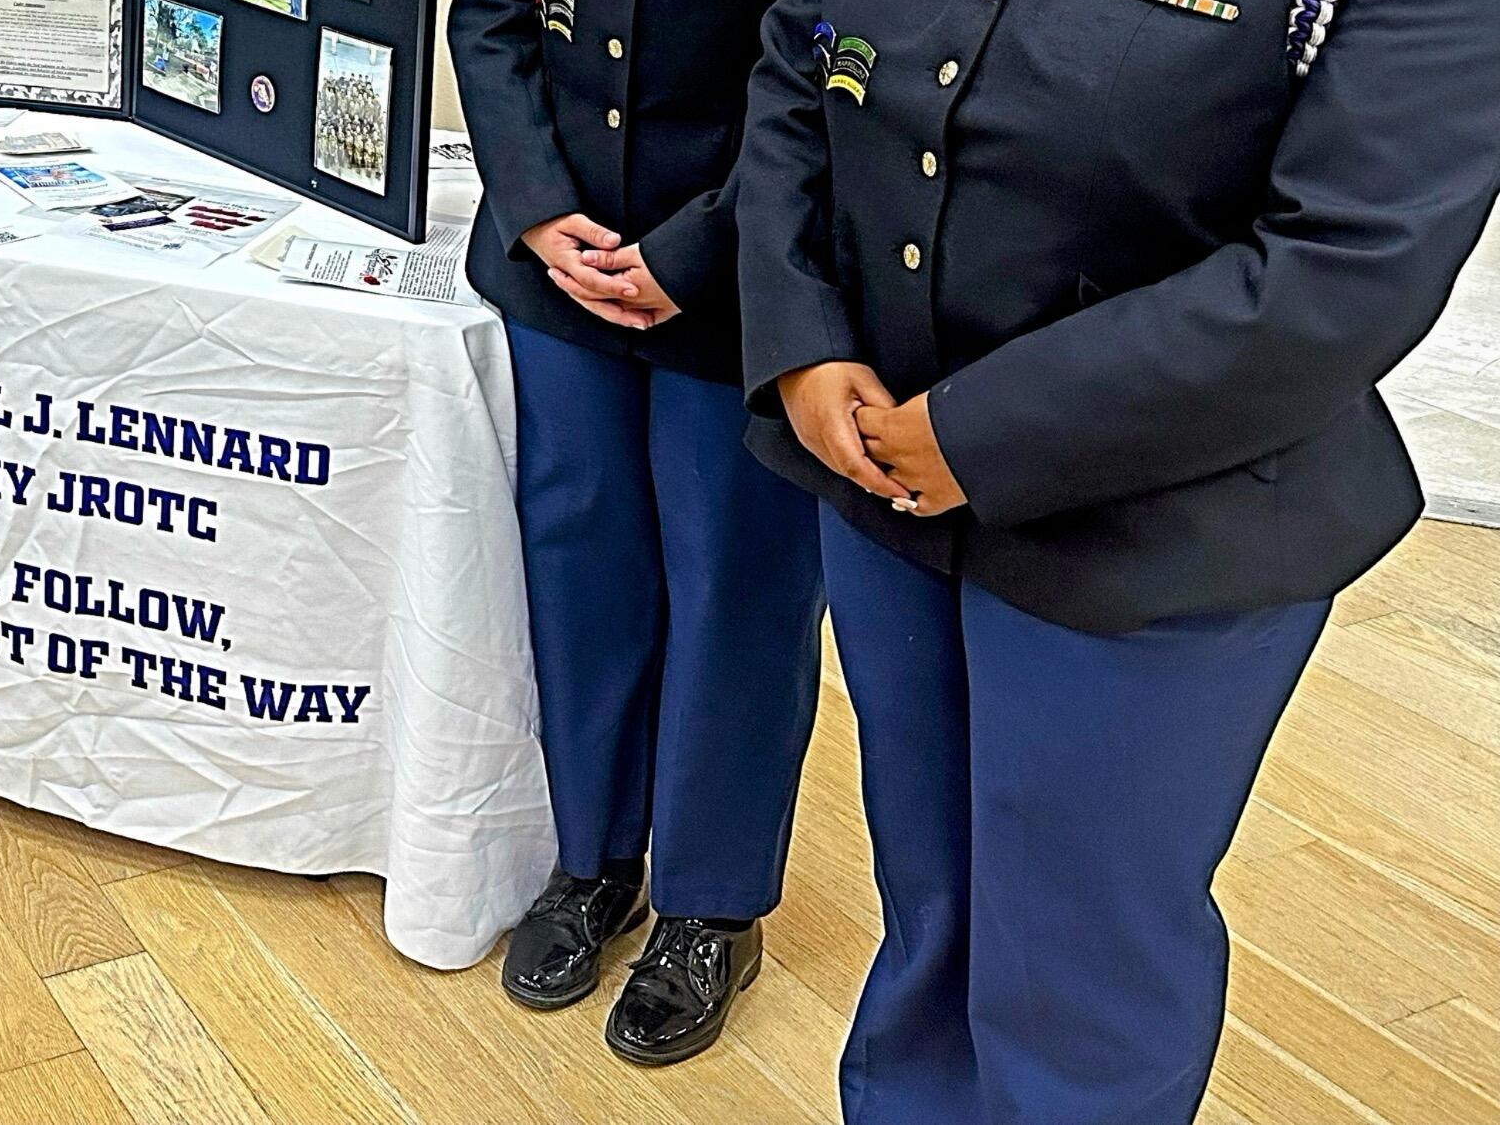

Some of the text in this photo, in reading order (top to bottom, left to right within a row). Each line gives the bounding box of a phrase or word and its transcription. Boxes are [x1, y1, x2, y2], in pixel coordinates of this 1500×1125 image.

[23, 393, 63, 439] J.
[76, 401, 331, 486] LENNARD
[48, 472, 217, 542] JROTC
[12, 561, 233, 651] FOLLOW,
[48, 633, 110, 679] OF
[121, 646, 227, 711] THE
[241, 674, 371, 724] WAY
